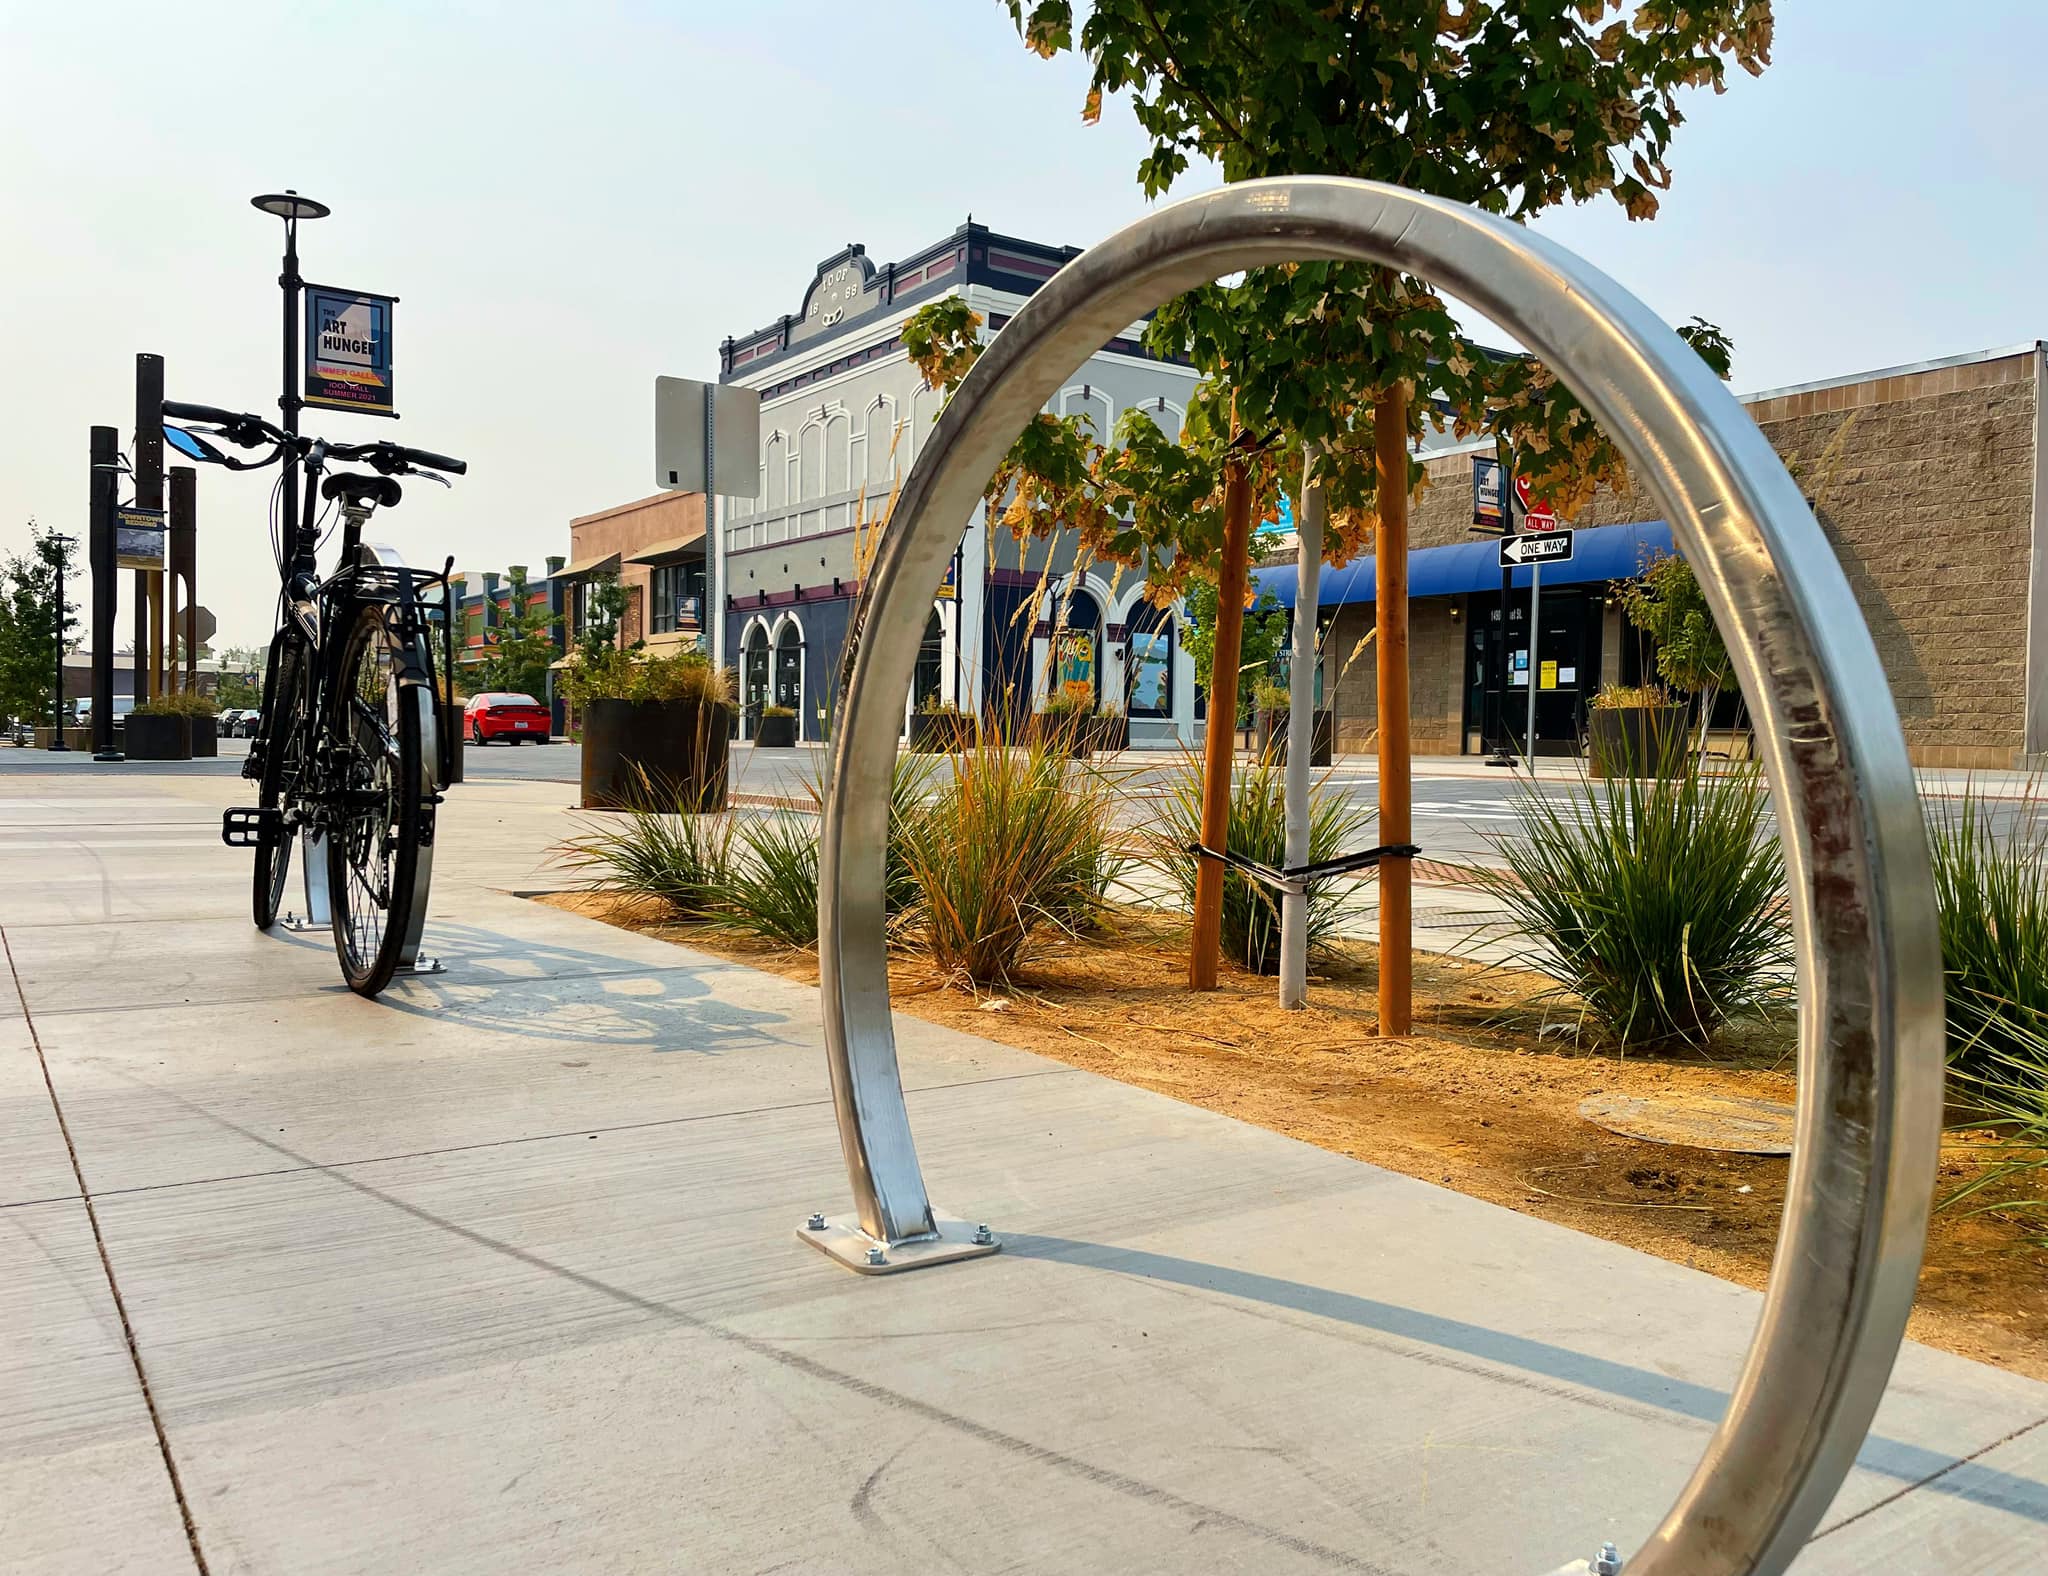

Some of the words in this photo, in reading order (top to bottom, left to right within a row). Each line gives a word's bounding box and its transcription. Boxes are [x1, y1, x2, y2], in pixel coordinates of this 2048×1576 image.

[322, 318, 347, 335] ART
[323, 335, 376, 356] HUNGER
[323, 388, 357, 399] SUMMER
[359, 391, 376, 401] 2021
[1527, 519, 1538, 529] ALL
[1541, 520, 1553, 530] WAY
[1520, 543, 1541, 555] ONE
[1543, 540, 1565, 552] WAY
